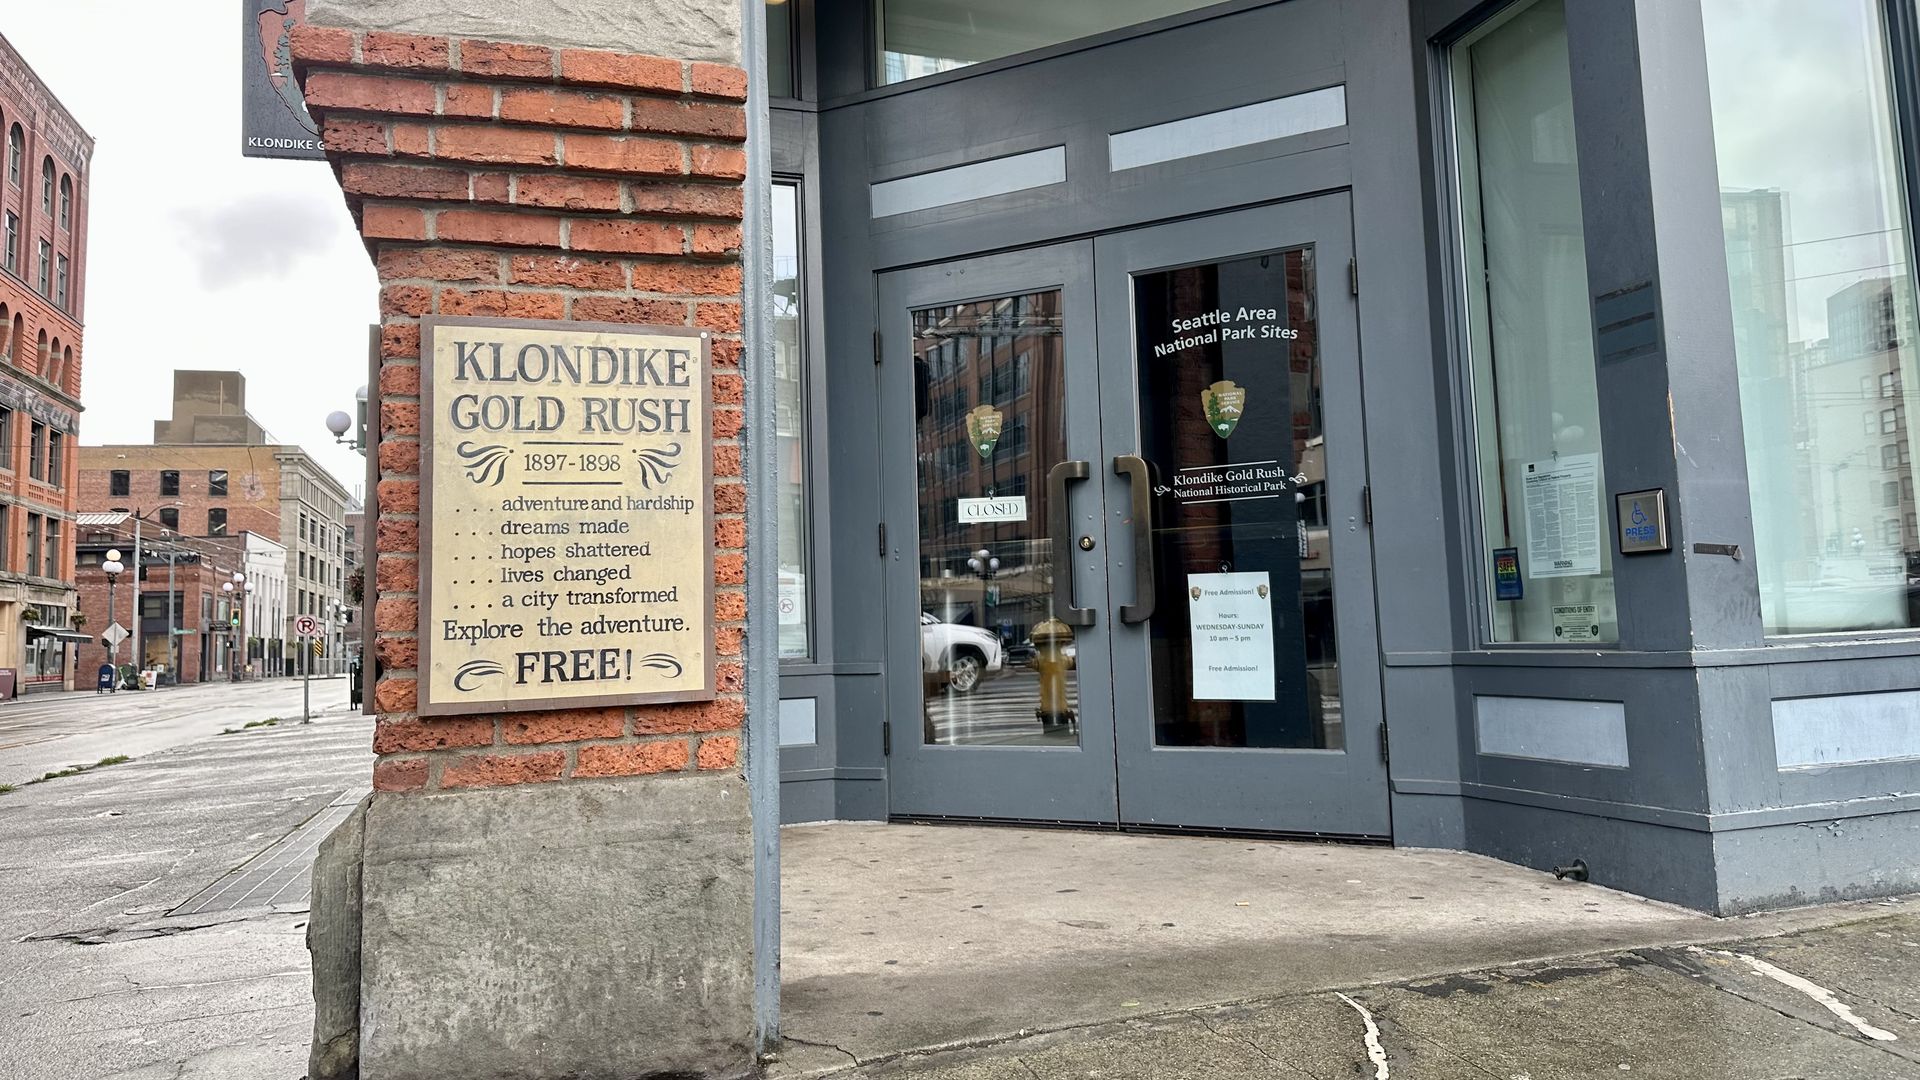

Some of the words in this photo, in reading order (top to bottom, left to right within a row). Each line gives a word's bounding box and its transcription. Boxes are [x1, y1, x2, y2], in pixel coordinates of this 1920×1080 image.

[248, 137, 313, 150] KLONDIKE
[1171, 308, 1231, 334] Seattle
[1236, 306, 1277, 322] Area
[1154, 329, 1218, 358] National
[1222, 325, 1256, 341] Park
[1260, 324, 1298, 340] Sites
[453, 341, 691, 388] KLONDIKE
[451, 393, 566, 433] GOLD
[581, 397, 691, 434] RUSH
[524, 454, 621, 472] 1897-1898
[1173, 473, 1223, 486] Klondike
[1225, 469, 1253, 482] Gold
[1256, 467, 1285, 479] Rush
[1173, 486, 1213, 499] National
[1215, 483, 1262, 495] Historical
[1264, 481, 1286, 492] Park
[502, 496, 588, 511] adventure
[591, 496, 622, 511] and
[626, 495, 694, 514] hardship
[967, 502, 1019, 517] CLOSED
[501, 520, 570, 535] dreams
[579, 519, 629, 534] made
[1625, 525, 1655, 537] PRESS
[501, 544, 556, 562] hopes
[565, 541, 651, 558] shattered
[501, 567, 544, 583] lives
[553, 565, 631, 585] changed
[502, 594, 514, 607] a
[521, 591, 559, 610] city
[566, 586, 678, 605] transformed
[1219, 588, 1254, 596] Admission!
[443, 619, 524, 646] Explore
[537, 616, 572, 637] the
[581, 614, 690, 635] adventure.
[1195, 623, 1265, 631] WEDNESDAY-SUNDAY
[514, 648, 632, 685] FREE!
[1223, 664, 1258, 672] Admission!
